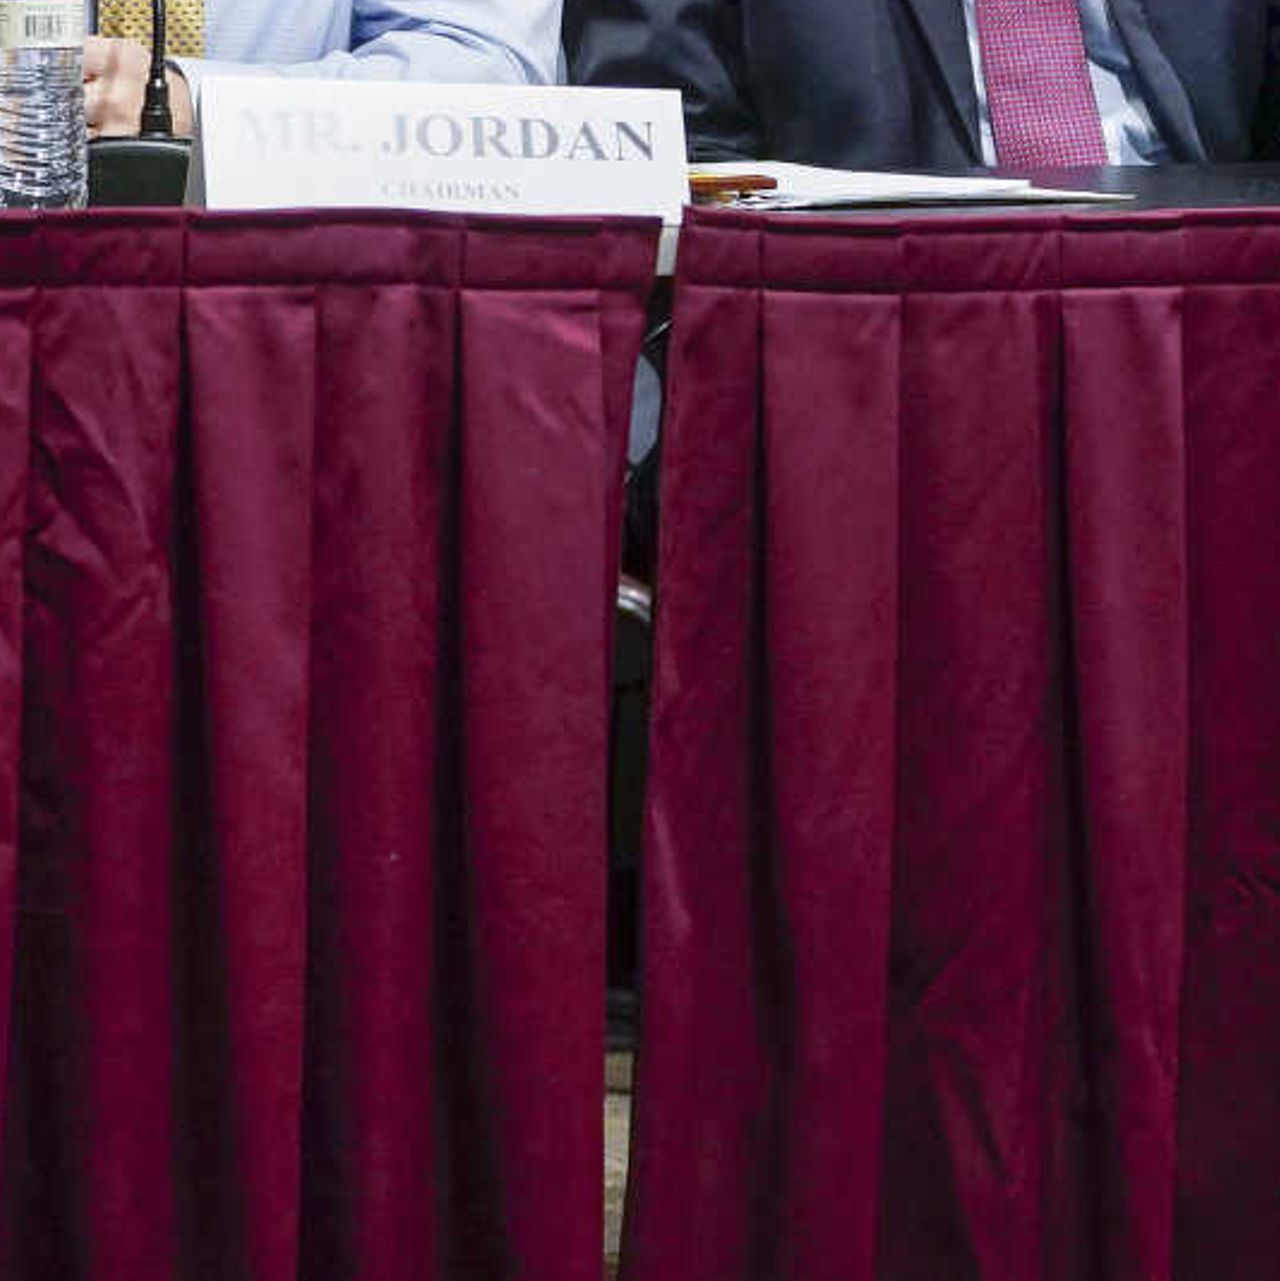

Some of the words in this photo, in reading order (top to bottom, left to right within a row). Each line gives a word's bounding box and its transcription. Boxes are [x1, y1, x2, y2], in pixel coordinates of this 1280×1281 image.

[238, 106, 363, 154] MR.
[380, 111, 656, 162] JORDAN
[380, 179, 521, 201] CHAIRMAN
